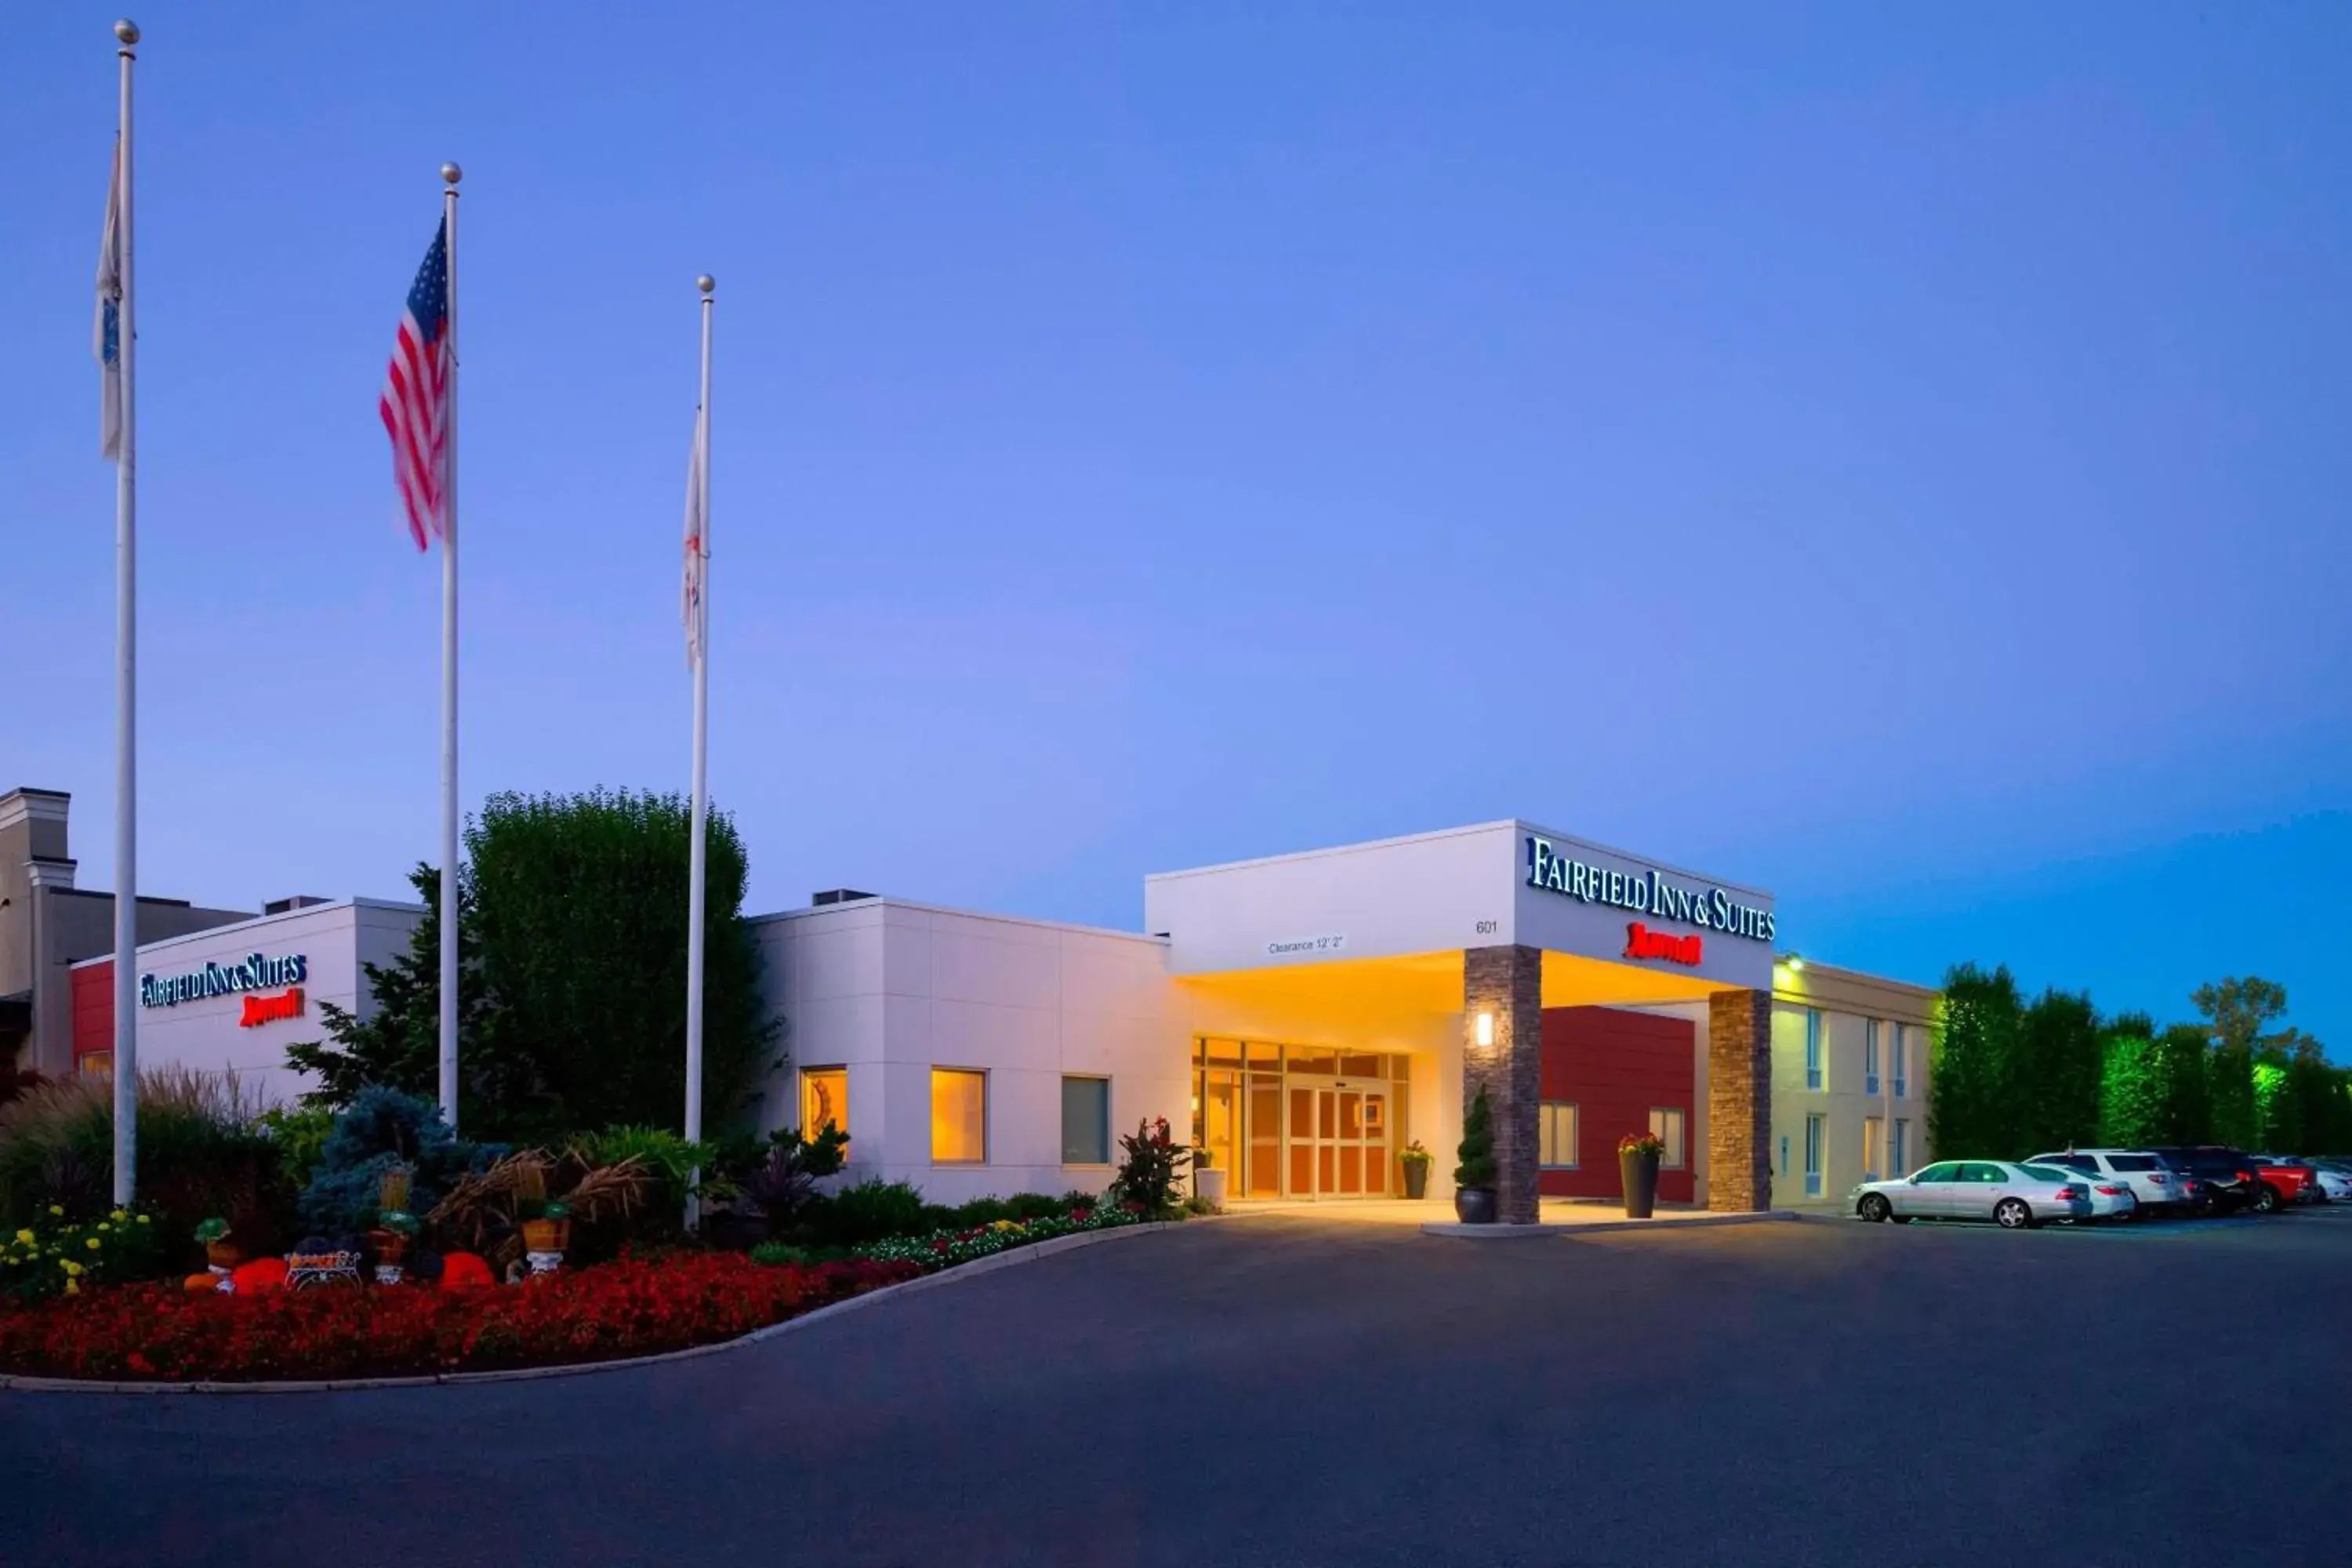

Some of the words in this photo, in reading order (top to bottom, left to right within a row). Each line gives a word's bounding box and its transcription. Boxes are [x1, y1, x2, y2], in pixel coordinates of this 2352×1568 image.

[1528, 837, 1647, 911] FAIRFIELD
[1649, 871, 1691, 920] INN
[1693, 893, 1710, 926] &
[1712, 888, 1775, 942] SUITES
[1476, 920, 1497, 934] 601
[244, 953, 303, 989] SUITES
